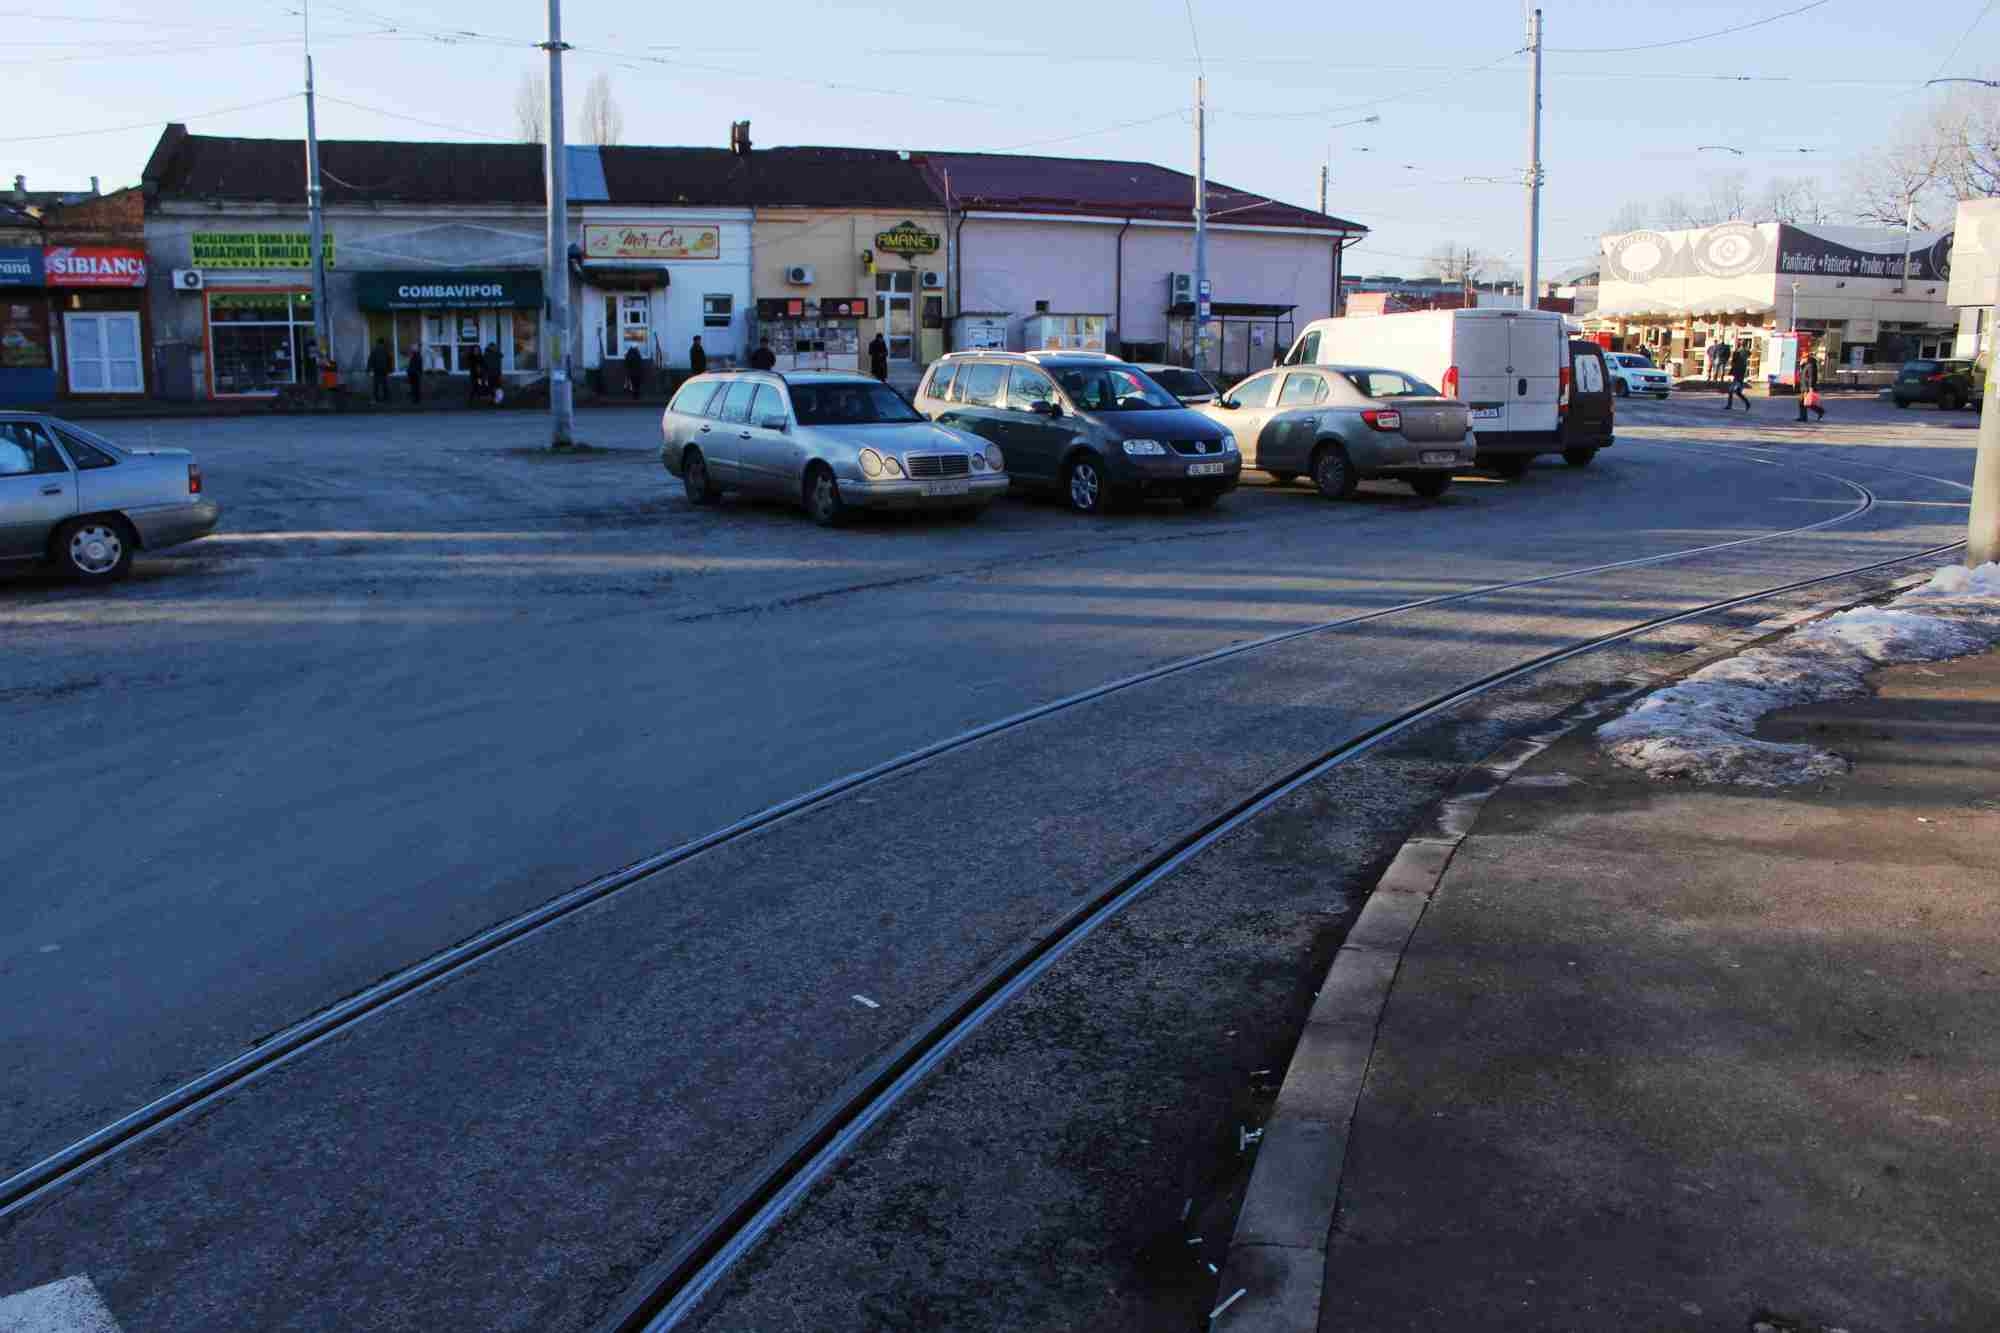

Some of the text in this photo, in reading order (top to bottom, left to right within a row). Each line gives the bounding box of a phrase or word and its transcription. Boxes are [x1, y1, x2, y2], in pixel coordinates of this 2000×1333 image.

[878, 234, 938, 249] AMANET
[54, 256, 145, 274] SIBIANCA
[398, 285, 502, 297] COMBAVIPOR
